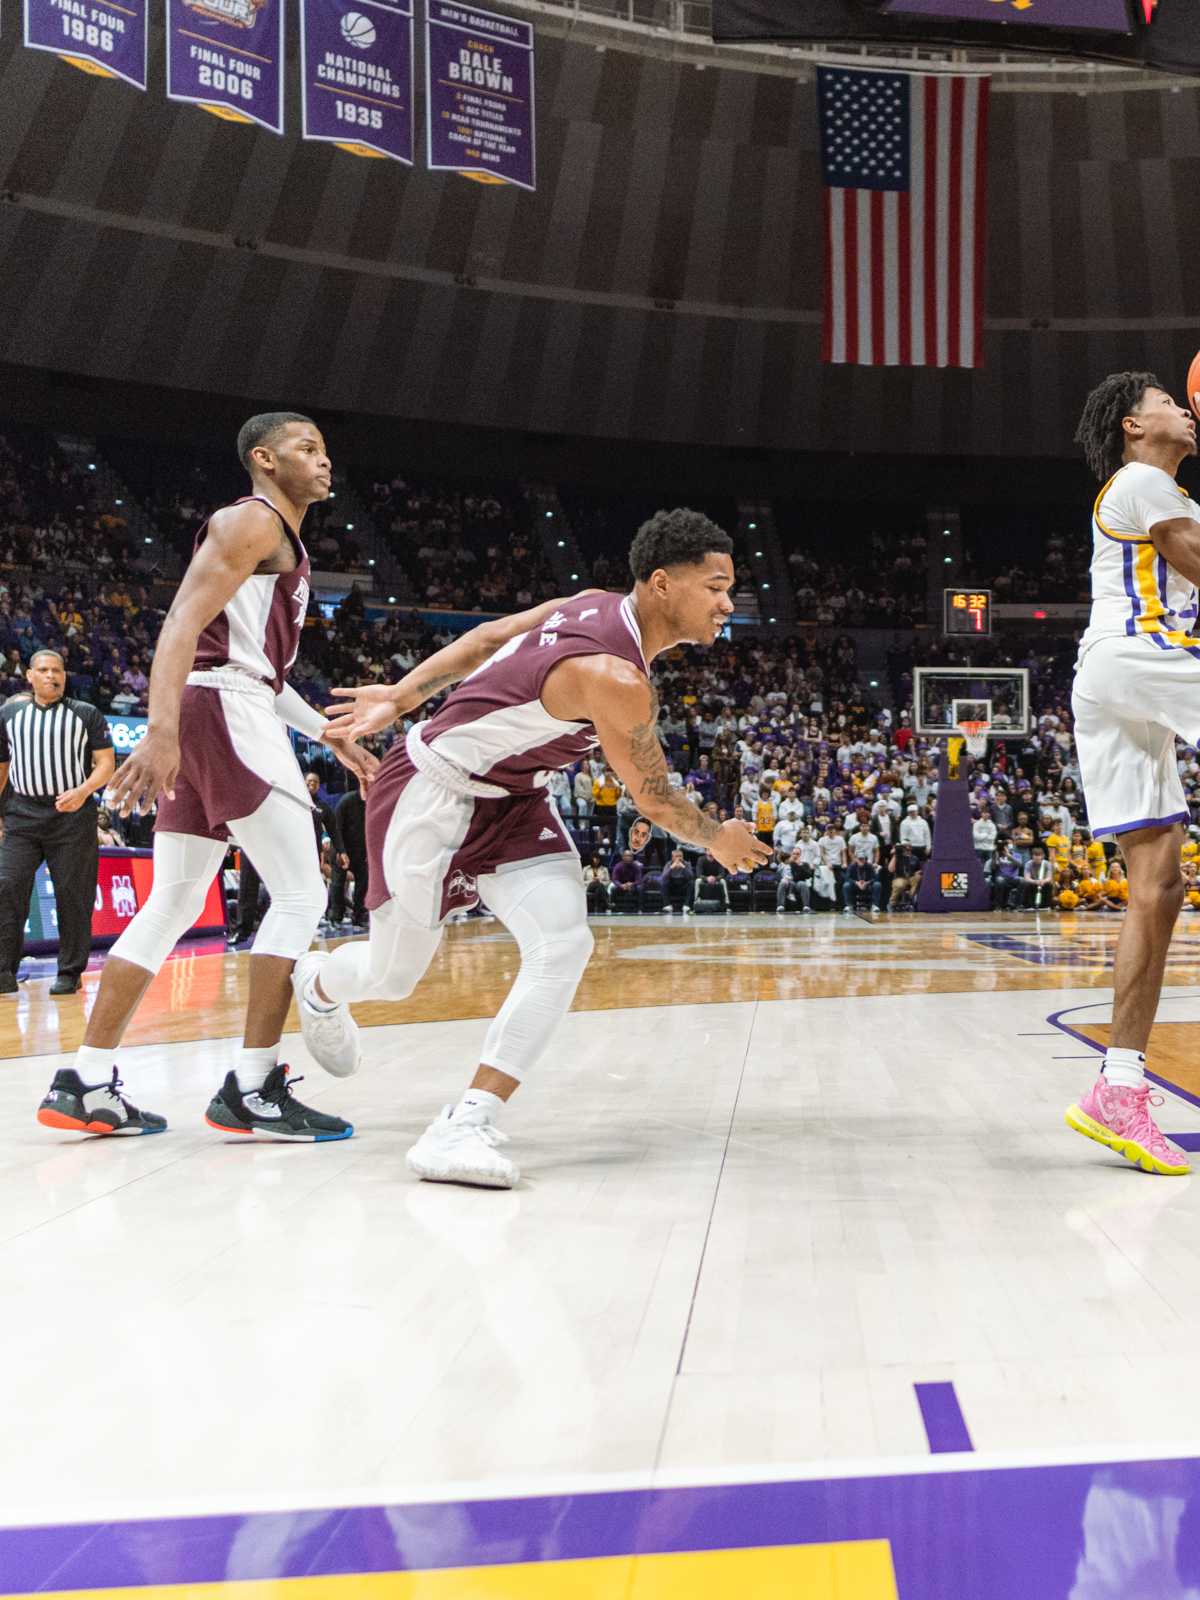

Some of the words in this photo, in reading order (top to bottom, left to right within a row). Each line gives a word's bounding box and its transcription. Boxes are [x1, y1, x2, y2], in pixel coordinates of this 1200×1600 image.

[62, 14, 114, 52] 1986
[91, 9, 125, 33] FOUR
[190, 45, 226, 69] FINAL
[229, 58, 261, 80] FOUR
[325, 52, 392, 82] NATIONAL
[459, 48, 502, 74] DALE
[198, 64, 253, 100] 2006
[317, 64, 400, 98] CHAMPIONS
[448, 61, 513, 93] BROWN
[336, 100, 383, 130] 1935
[968, 608, 982, 631] 7
